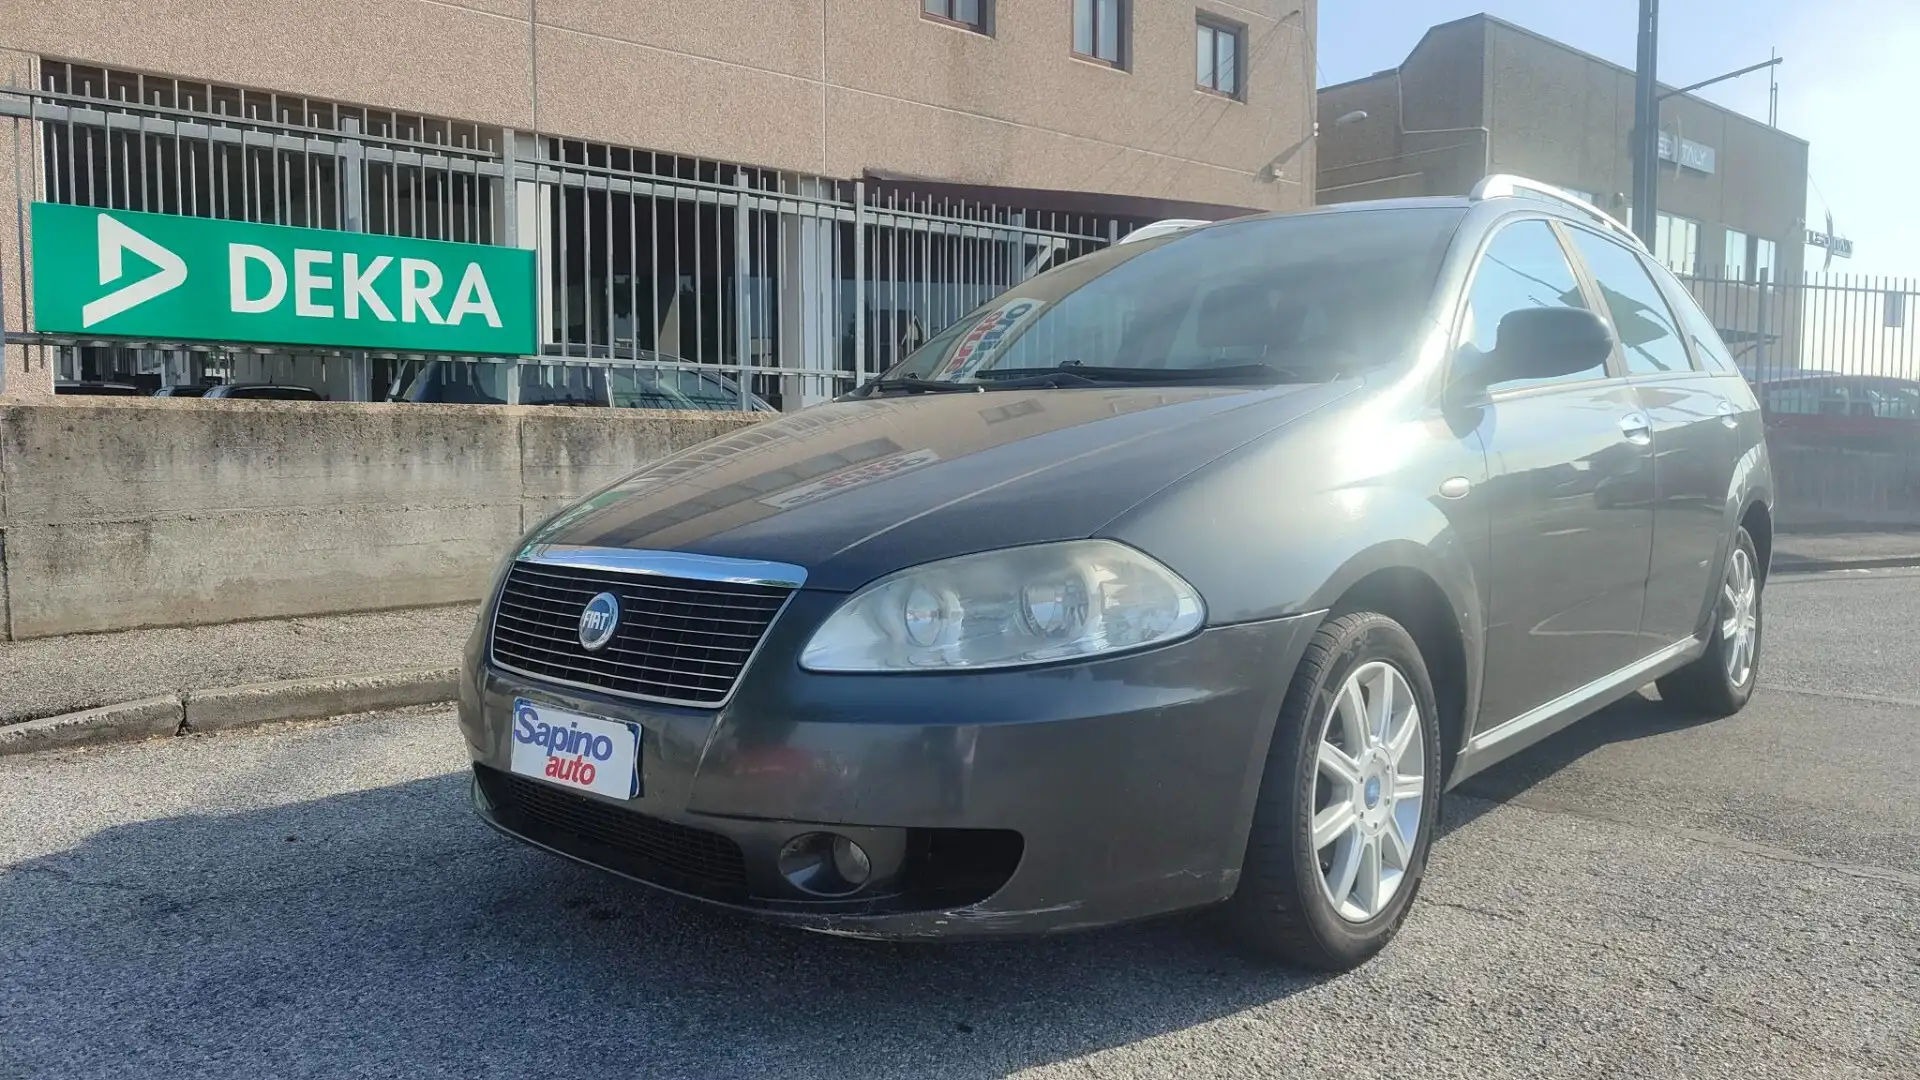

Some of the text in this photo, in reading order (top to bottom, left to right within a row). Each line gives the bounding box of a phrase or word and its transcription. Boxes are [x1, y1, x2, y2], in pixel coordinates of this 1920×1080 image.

[1659, 137, 1706, 165] ED TALY
[228, 242, 503, 328] DEKRA
[582, 611, 609, 630] FIAT
[514, 707, 613, 761] Sapino
[545, 755, 596, 786] auto
